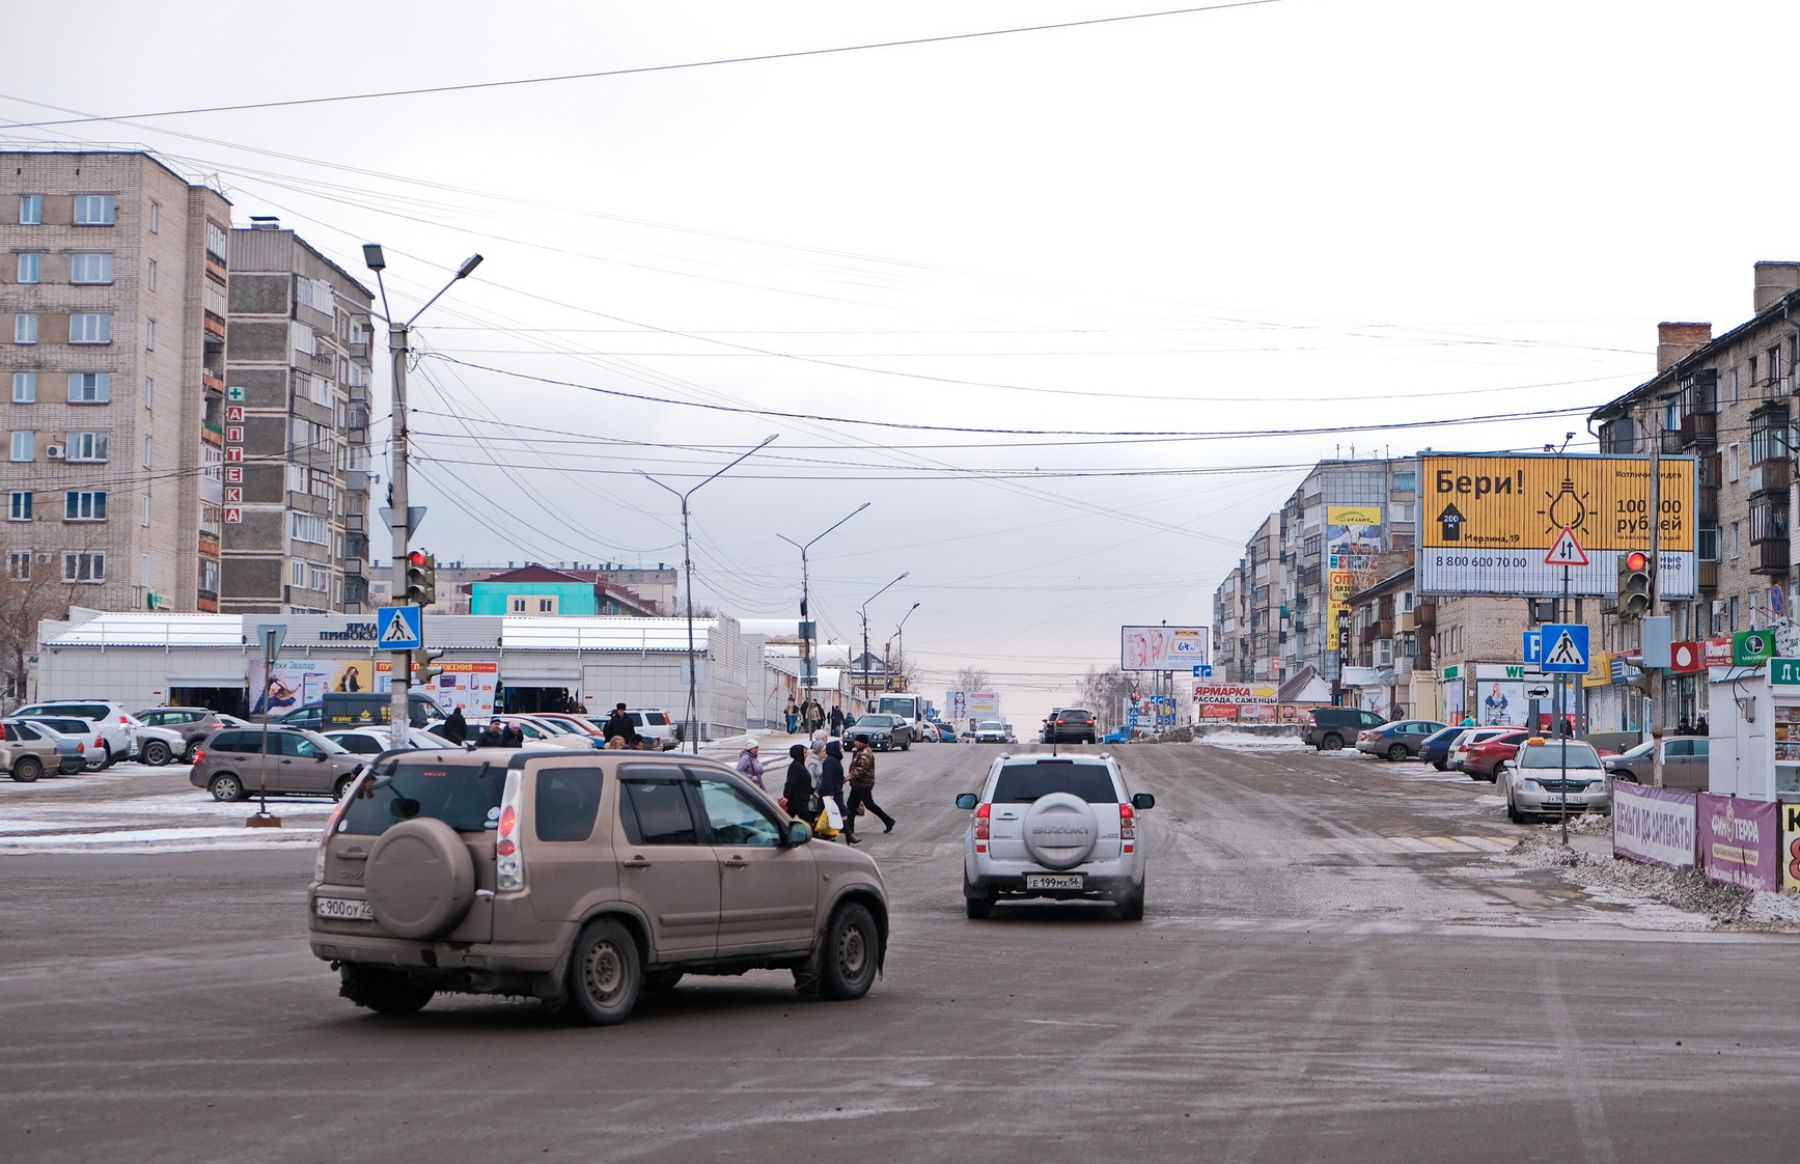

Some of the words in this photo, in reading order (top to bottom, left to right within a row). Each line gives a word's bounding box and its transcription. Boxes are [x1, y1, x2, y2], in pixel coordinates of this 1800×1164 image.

[227, 407, 242, 523] АПТЕКА
[1436, 469, 1523, 500] Бери!
[1617, 499, 1647, 513] 100
[1657, 500, 1682, 514] 00
[1443, 514, 1459, 523] 200
[1617, 515, 1682, 534] рубей
[1510, 533, 1520, 543] 19
[1436, 556, 1444, 567] 8
[1446, 556, 1469, 567] 800
[1471, 557, 1494, 568] 600
[1496, 557, 1511, 568] 70
[1512, 557, 1527, 568] 00
[1194, 686, 1250, 697] ЯРМАРКА
